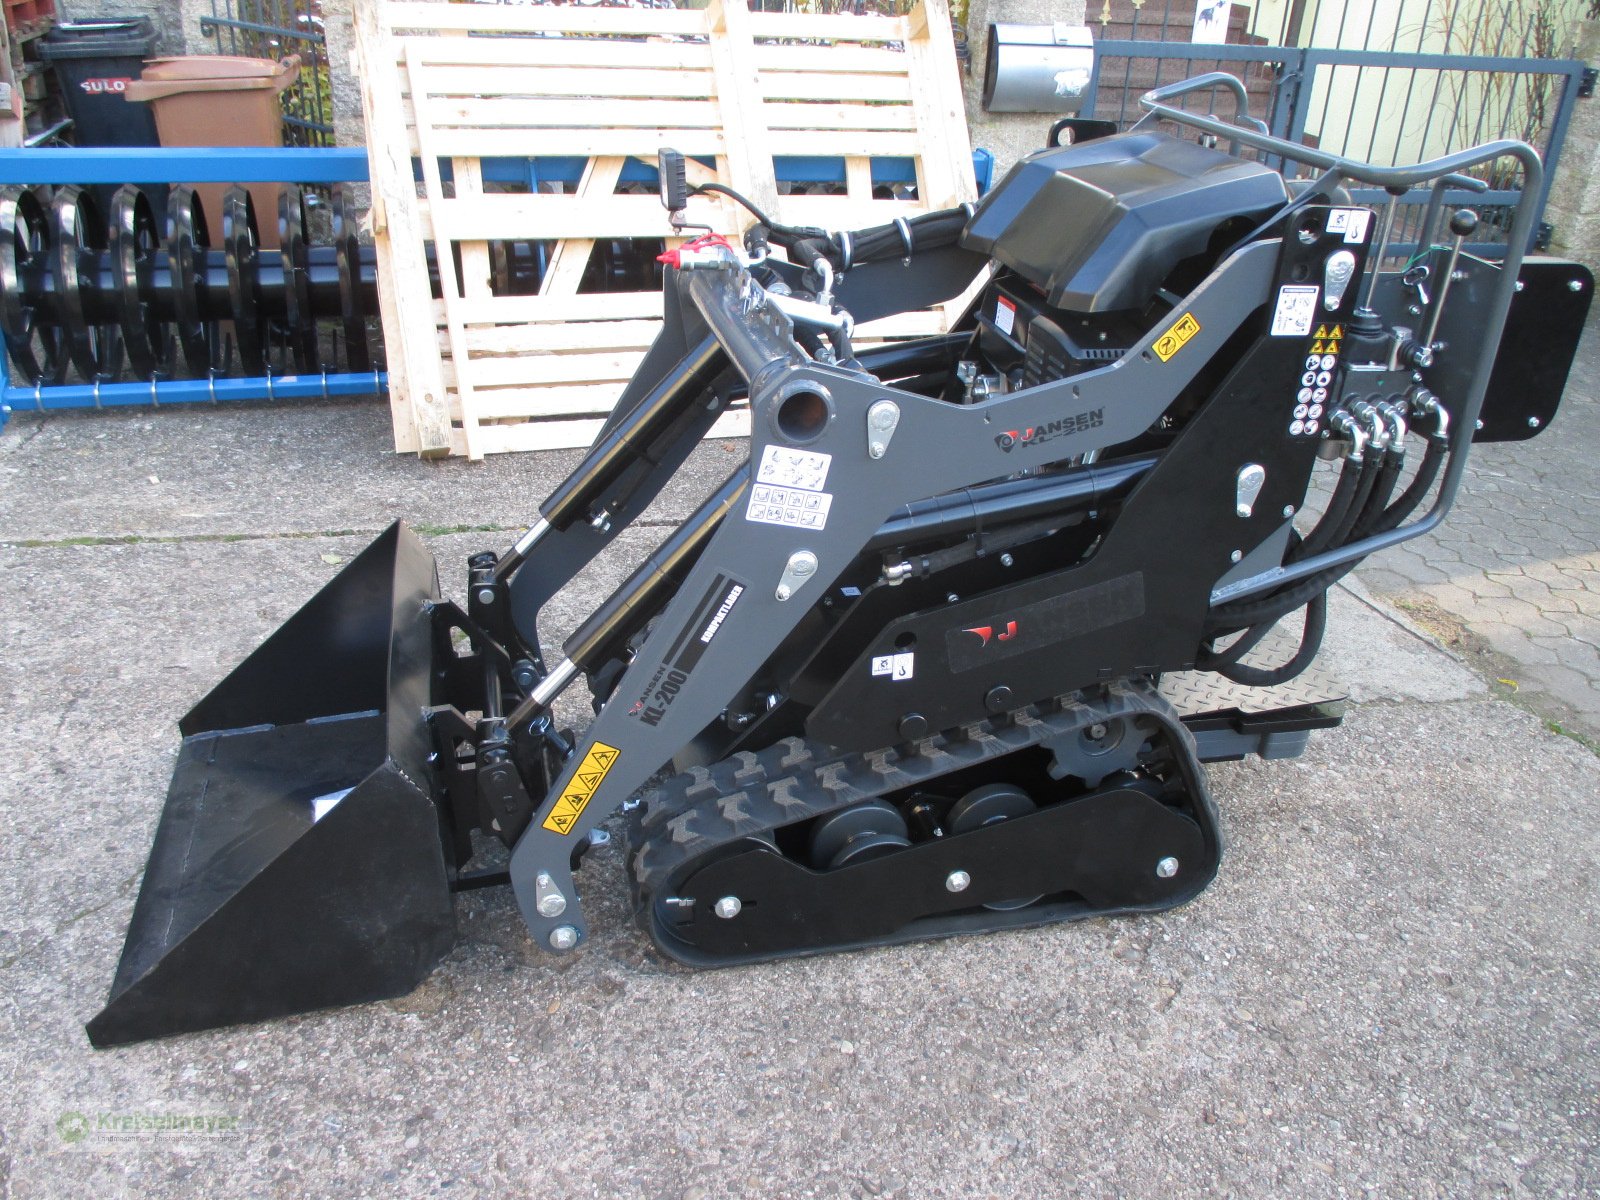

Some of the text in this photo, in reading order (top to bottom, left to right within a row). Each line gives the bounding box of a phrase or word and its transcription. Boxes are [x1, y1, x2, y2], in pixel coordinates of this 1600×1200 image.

[80, 80, 126, 91] SULO
[1021, 408, 1104, 442] JANSEN
[1022, 420, 1104, 448] KL-200
[700, 585, 744, 643] KOMPAKTLADER
[640, 670, 688, 727] KL-200
